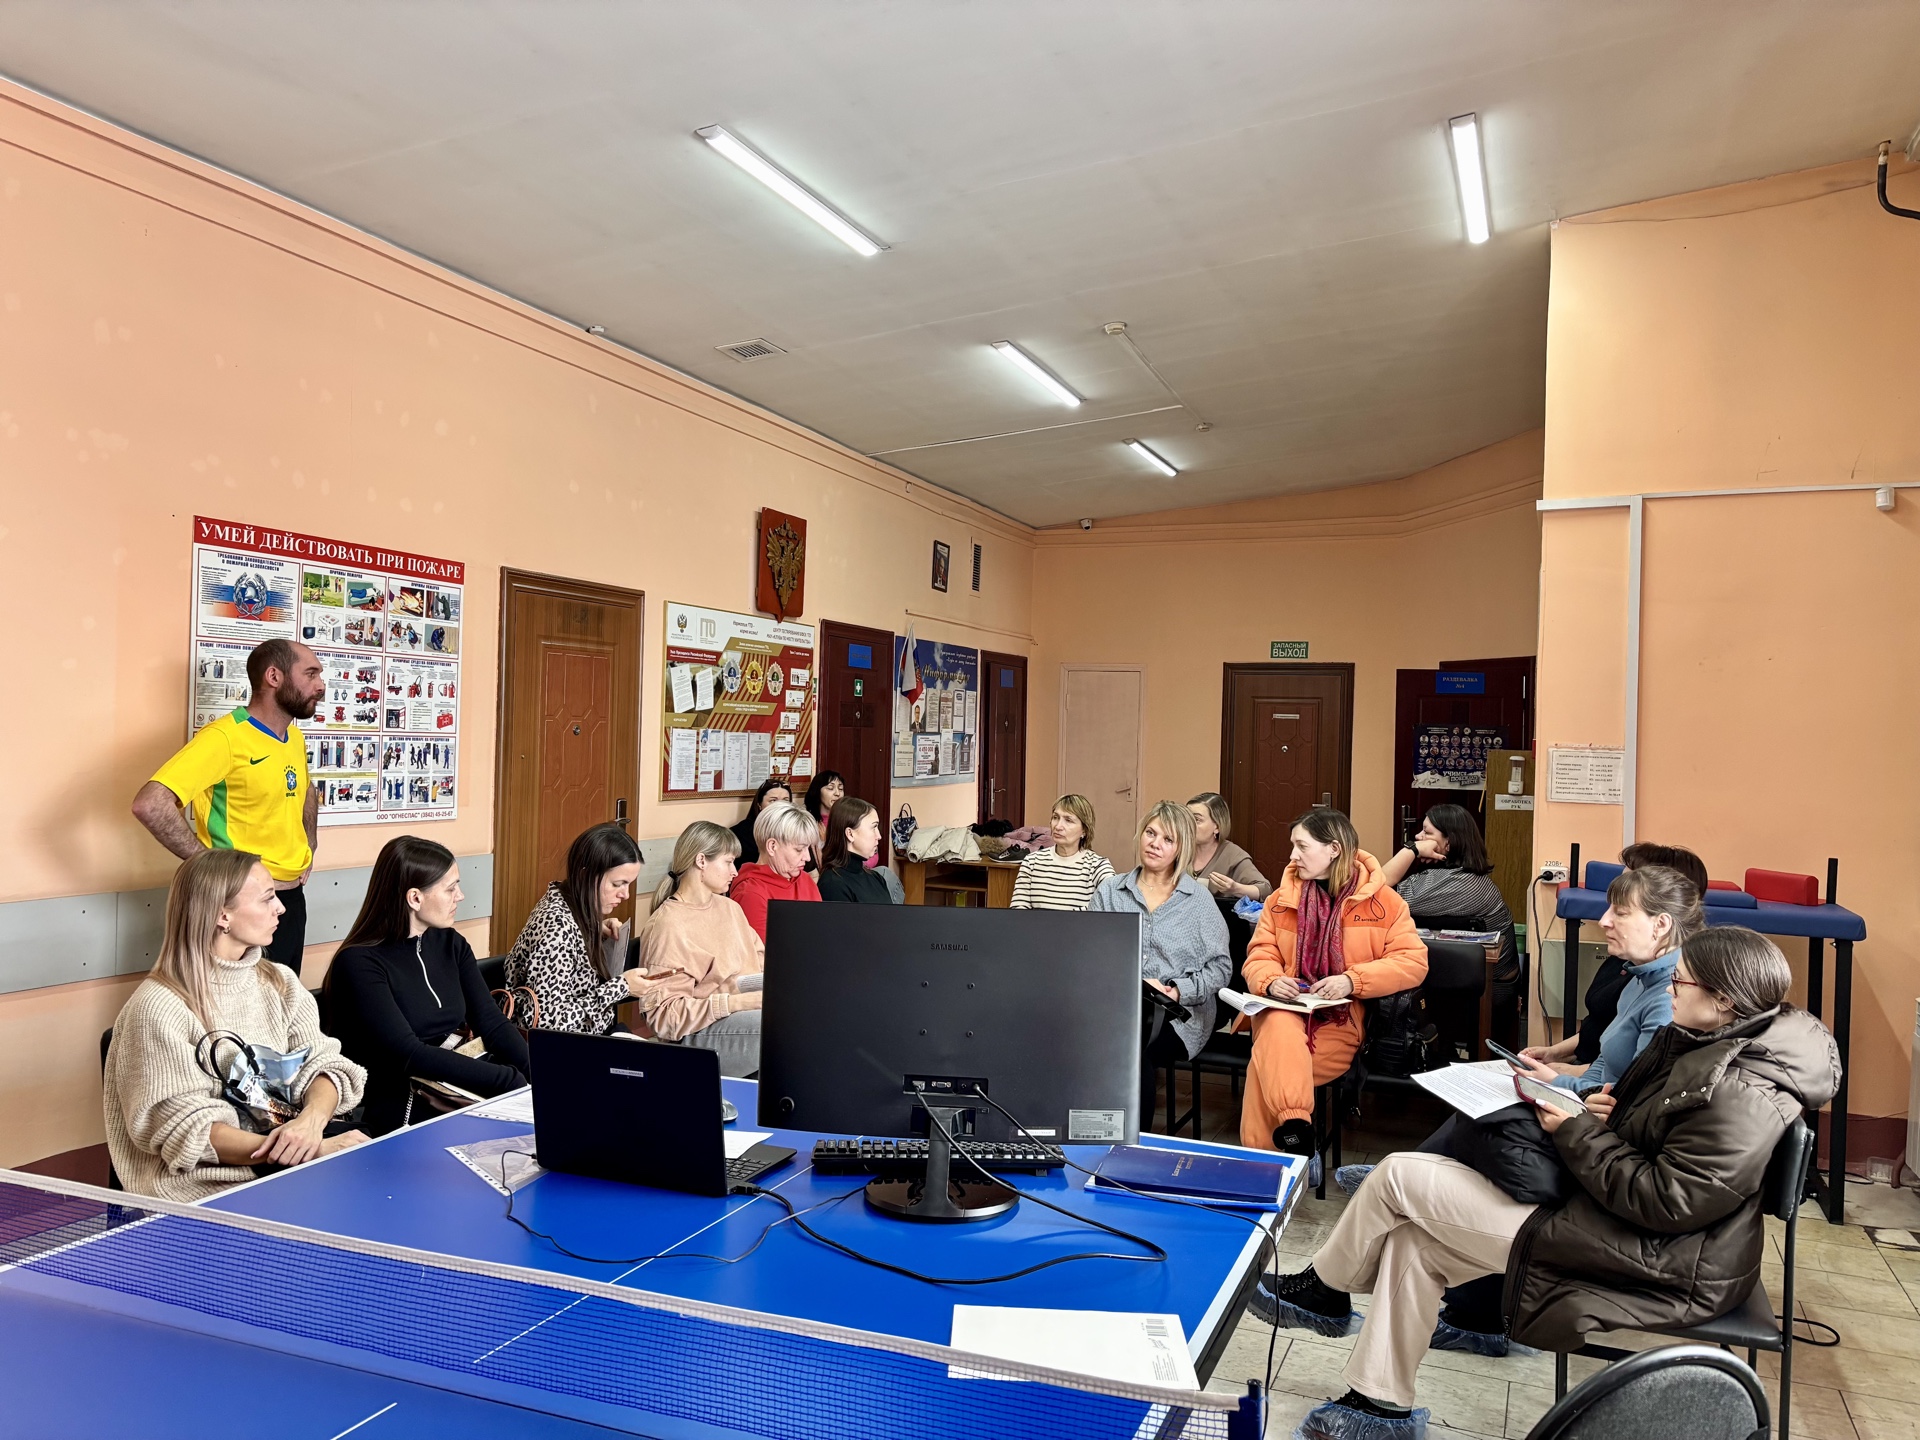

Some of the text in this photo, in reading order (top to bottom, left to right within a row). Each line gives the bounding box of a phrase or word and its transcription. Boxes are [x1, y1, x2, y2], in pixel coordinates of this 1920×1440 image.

[200, 522, 461, 579] УМЕЙ ДЕЙСТВОВАТЬ ПРИ ПОЖАРЕ
[1272, 648, 1306, 658] ВЫХОД
[376, 813, 389, 821] ООО
[389, 812, 421, 820] "ОГНЕСПАС"
[930, 943, 969, 951] SAMSUNG
